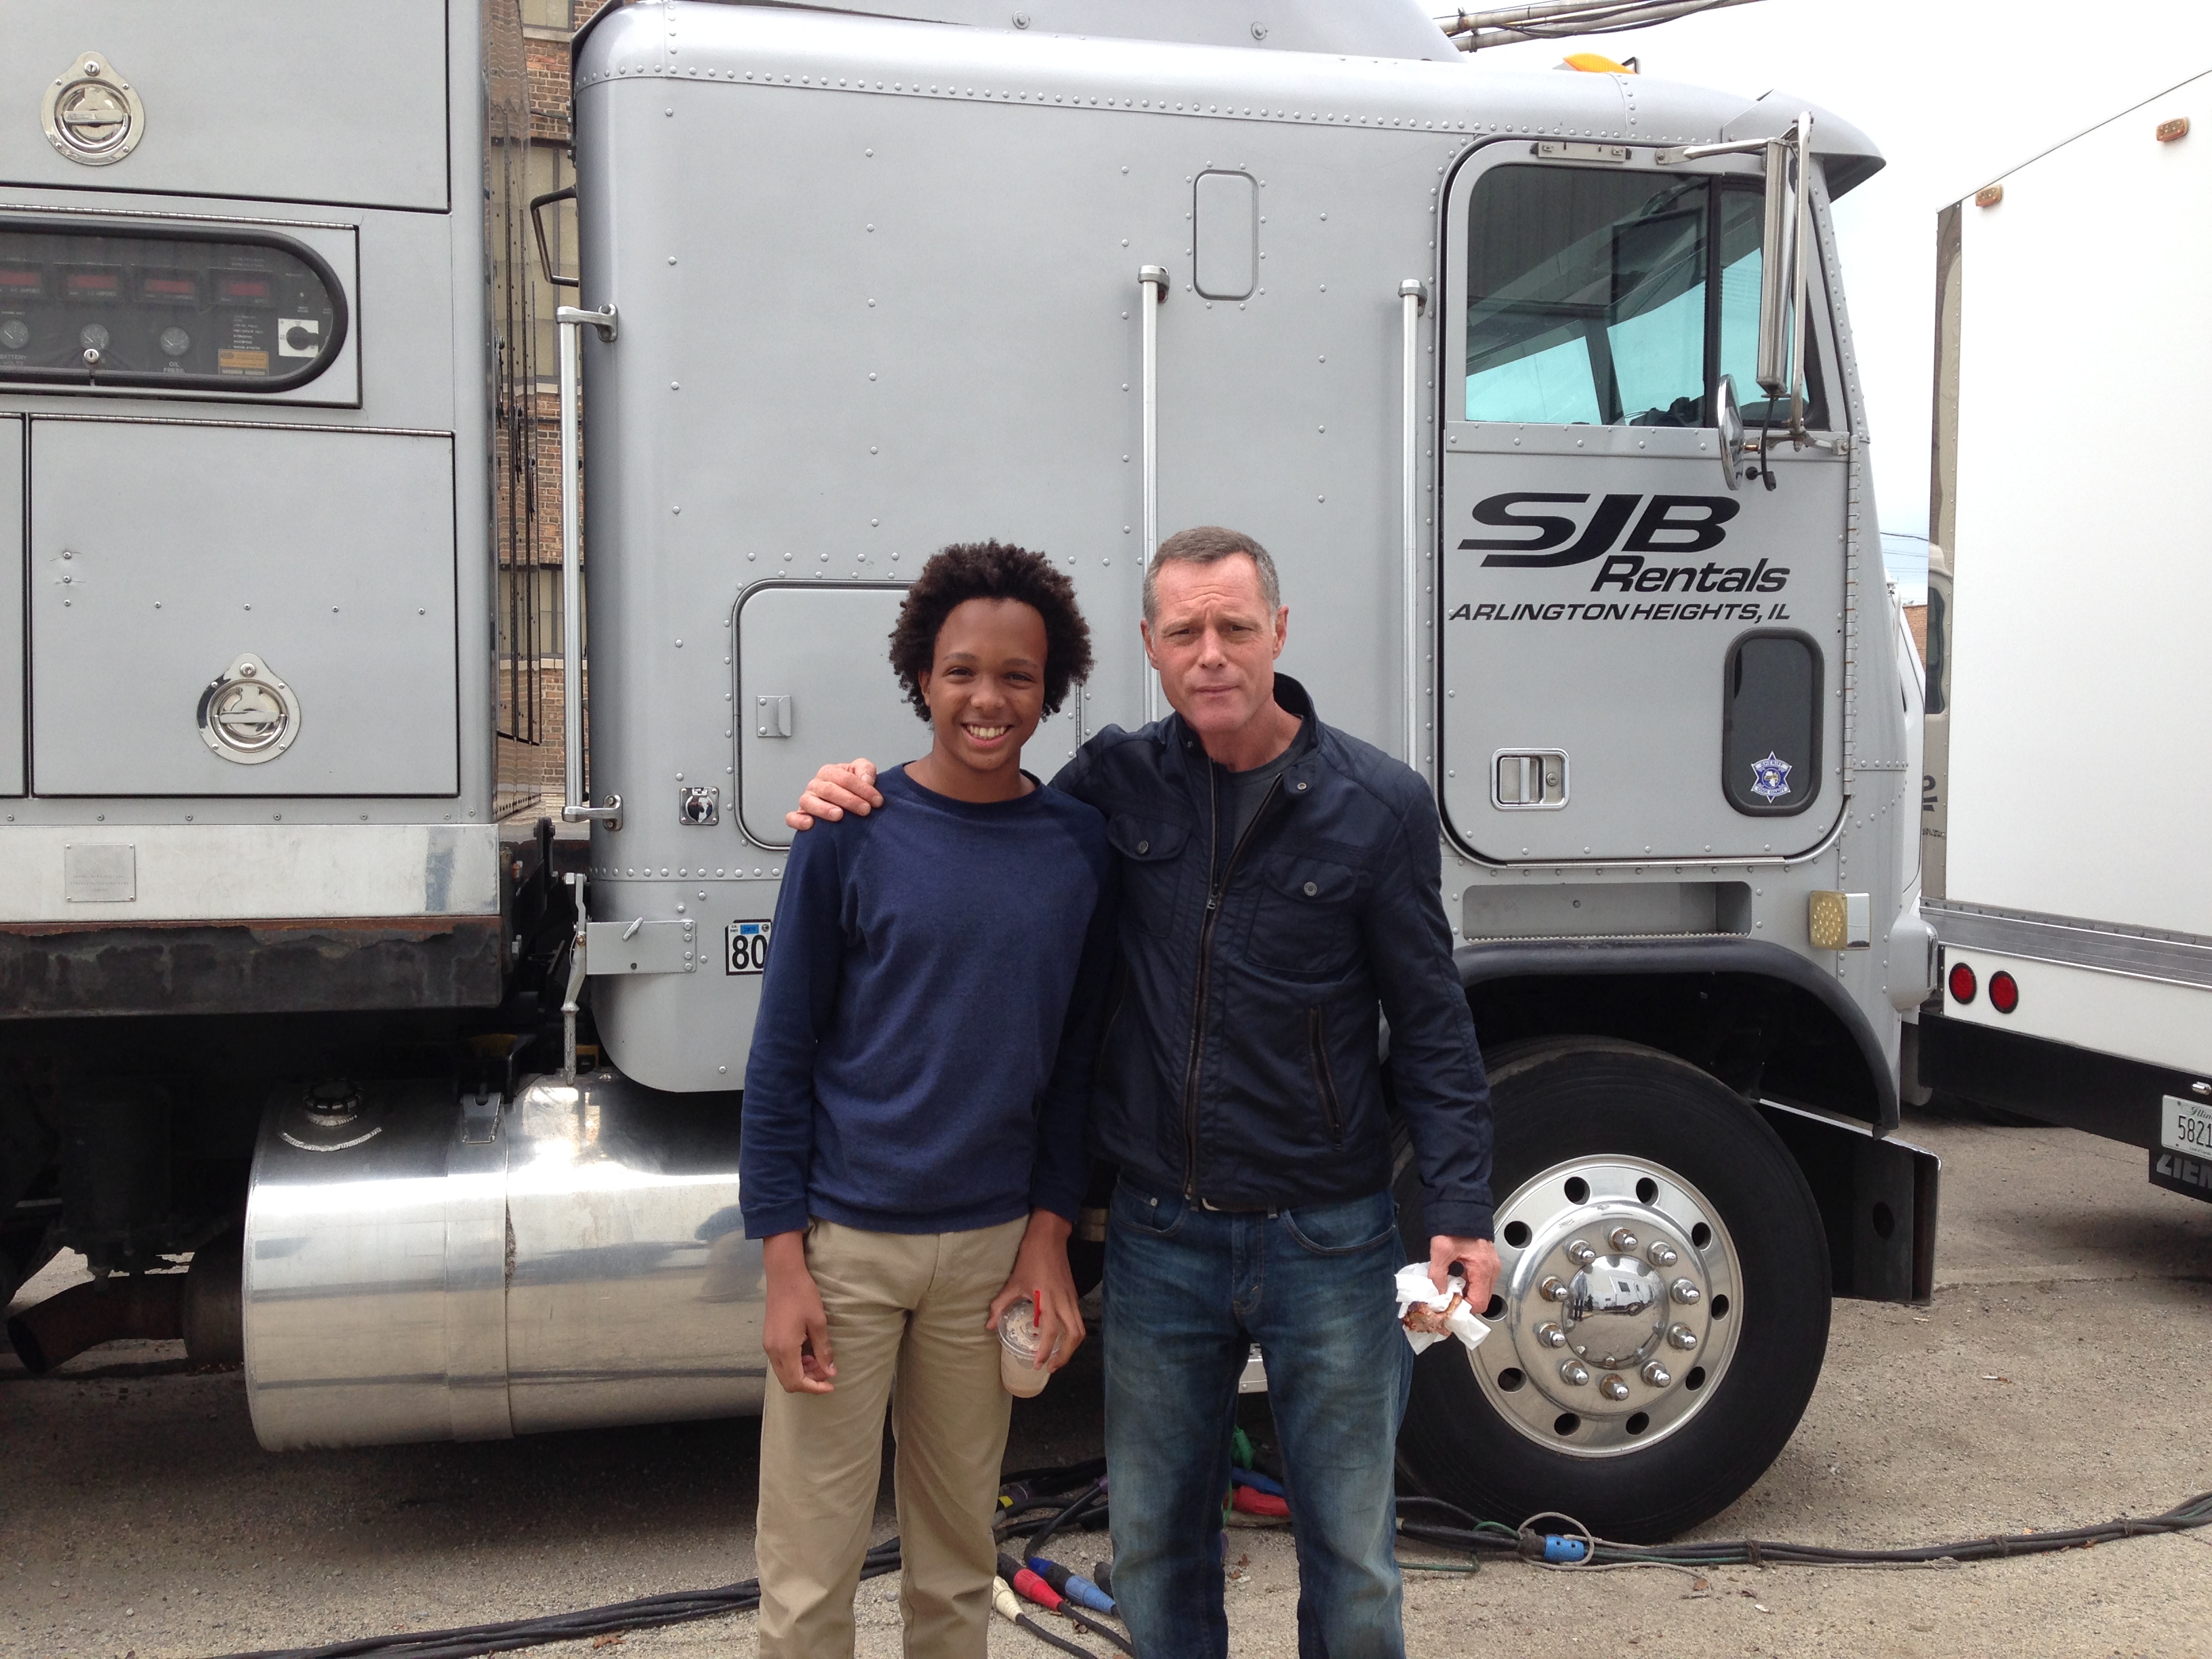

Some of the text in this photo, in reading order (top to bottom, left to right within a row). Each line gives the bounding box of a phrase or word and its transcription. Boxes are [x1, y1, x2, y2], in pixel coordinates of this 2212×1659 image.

[1457, 492, 1740, 568] SJB
[1590, 554, 1791, 594] Rentals
[1448, 602, 1791, 625] ARLINGTON HEIGHTS, IL
[732, 934, 768, 970] 80
[2181, 1104, 2212, 1120] Illin
